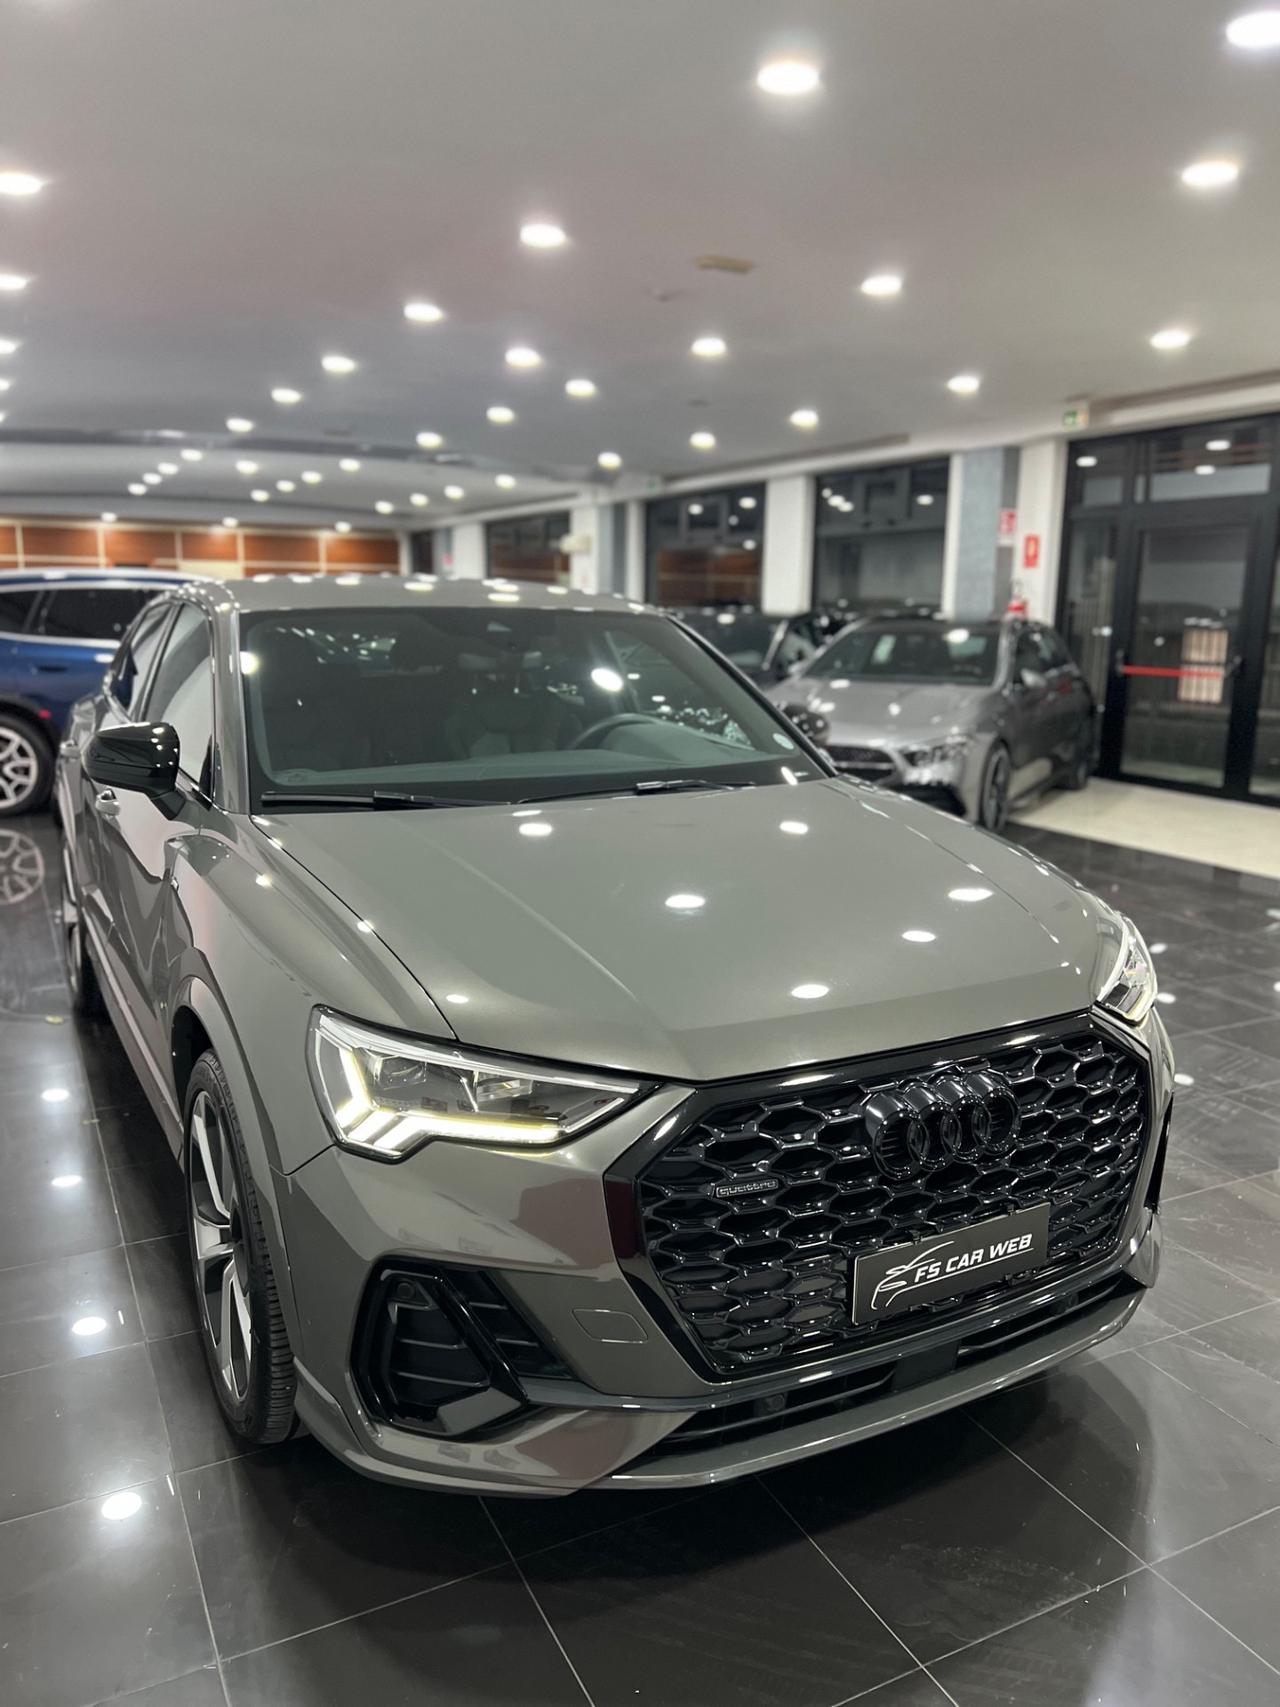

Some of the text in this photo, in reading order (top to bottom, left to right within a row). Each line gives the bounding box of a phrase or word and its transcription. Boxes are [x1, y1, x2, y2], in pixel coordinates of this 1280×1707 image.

[719, 1181, 776, 1196] quattro
[914, 1233, 1033, 1283] FS CAR WEB
